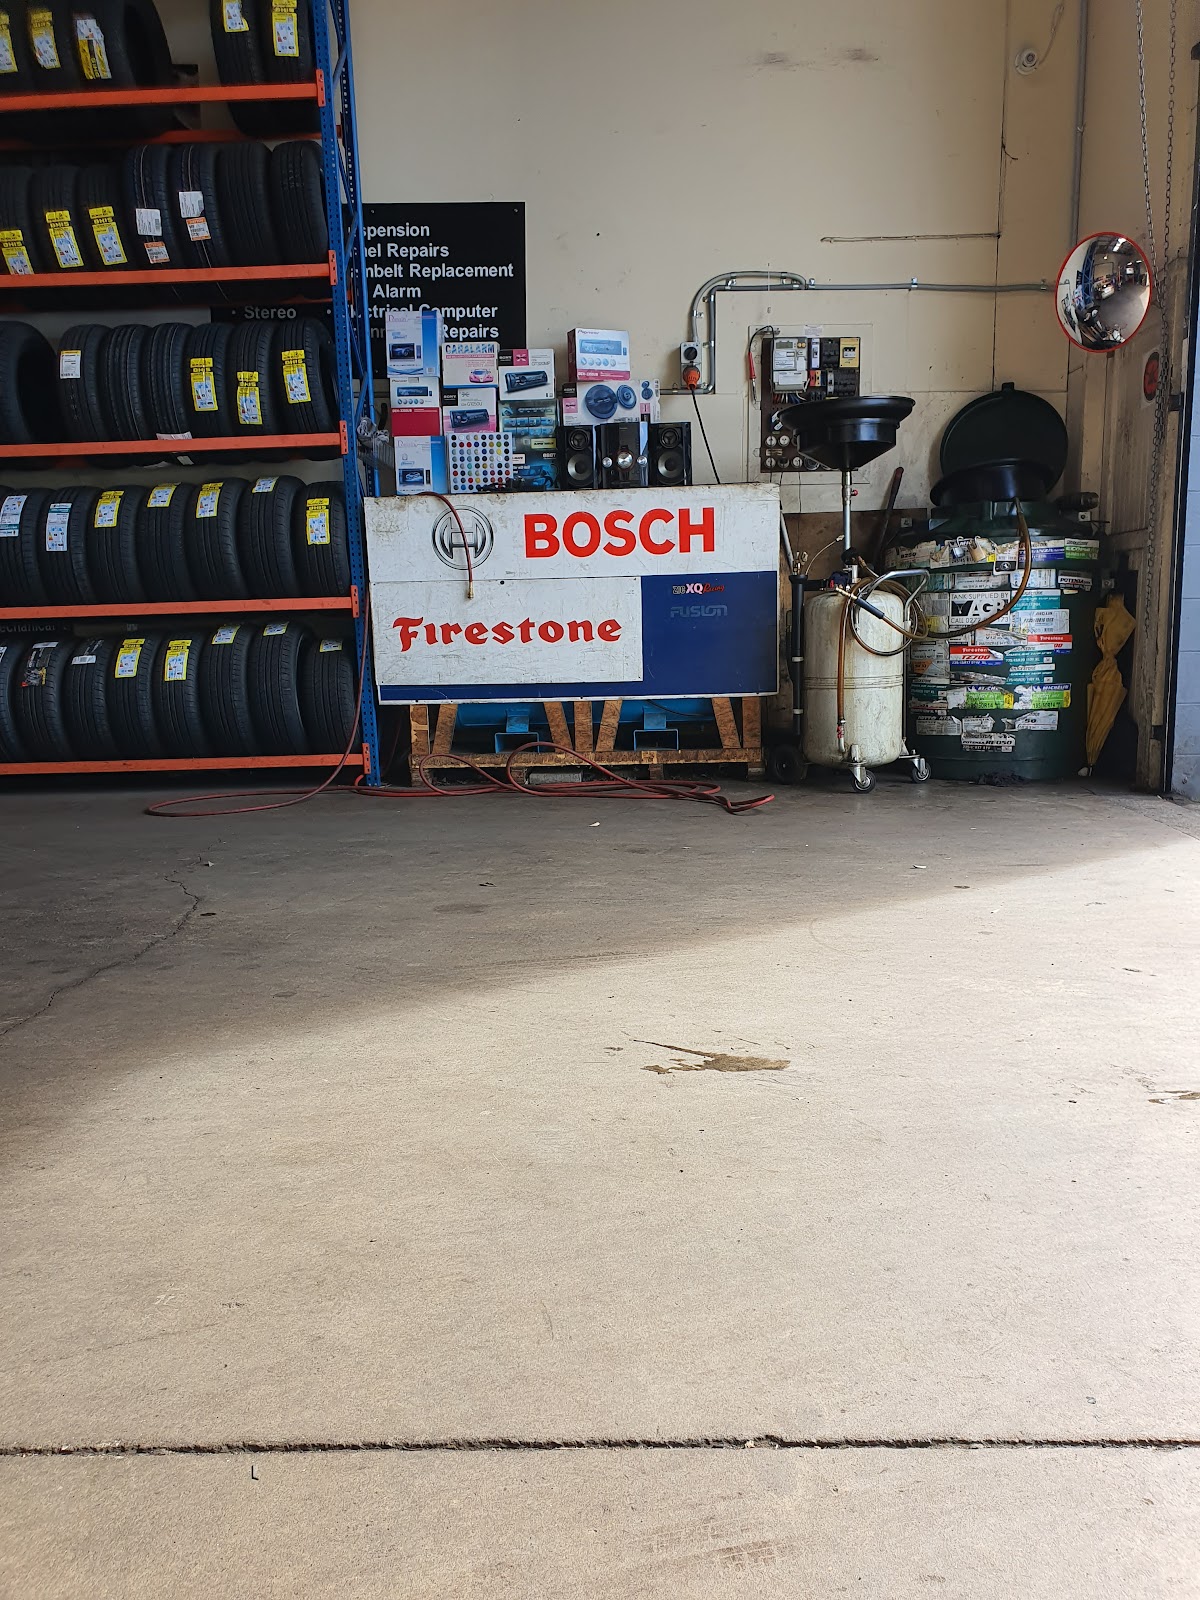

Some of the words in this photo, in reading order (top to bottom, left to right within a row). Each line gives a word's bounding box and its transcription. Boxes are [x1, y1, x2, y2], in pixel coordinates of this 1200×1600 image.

[387, 243, 449, 261] Repairs
[410, 263, 515, 282] Replacement
[373, 284, 422, 299] Alarm
[244, 305, 297, 319] Stereo
[523, 507, 716, 558] BOSCH
[968, 592, 999, 600] SUPPLIED
[670, 604, 728, 618] FUSION
[393, 616, 622, 652] Firestone
